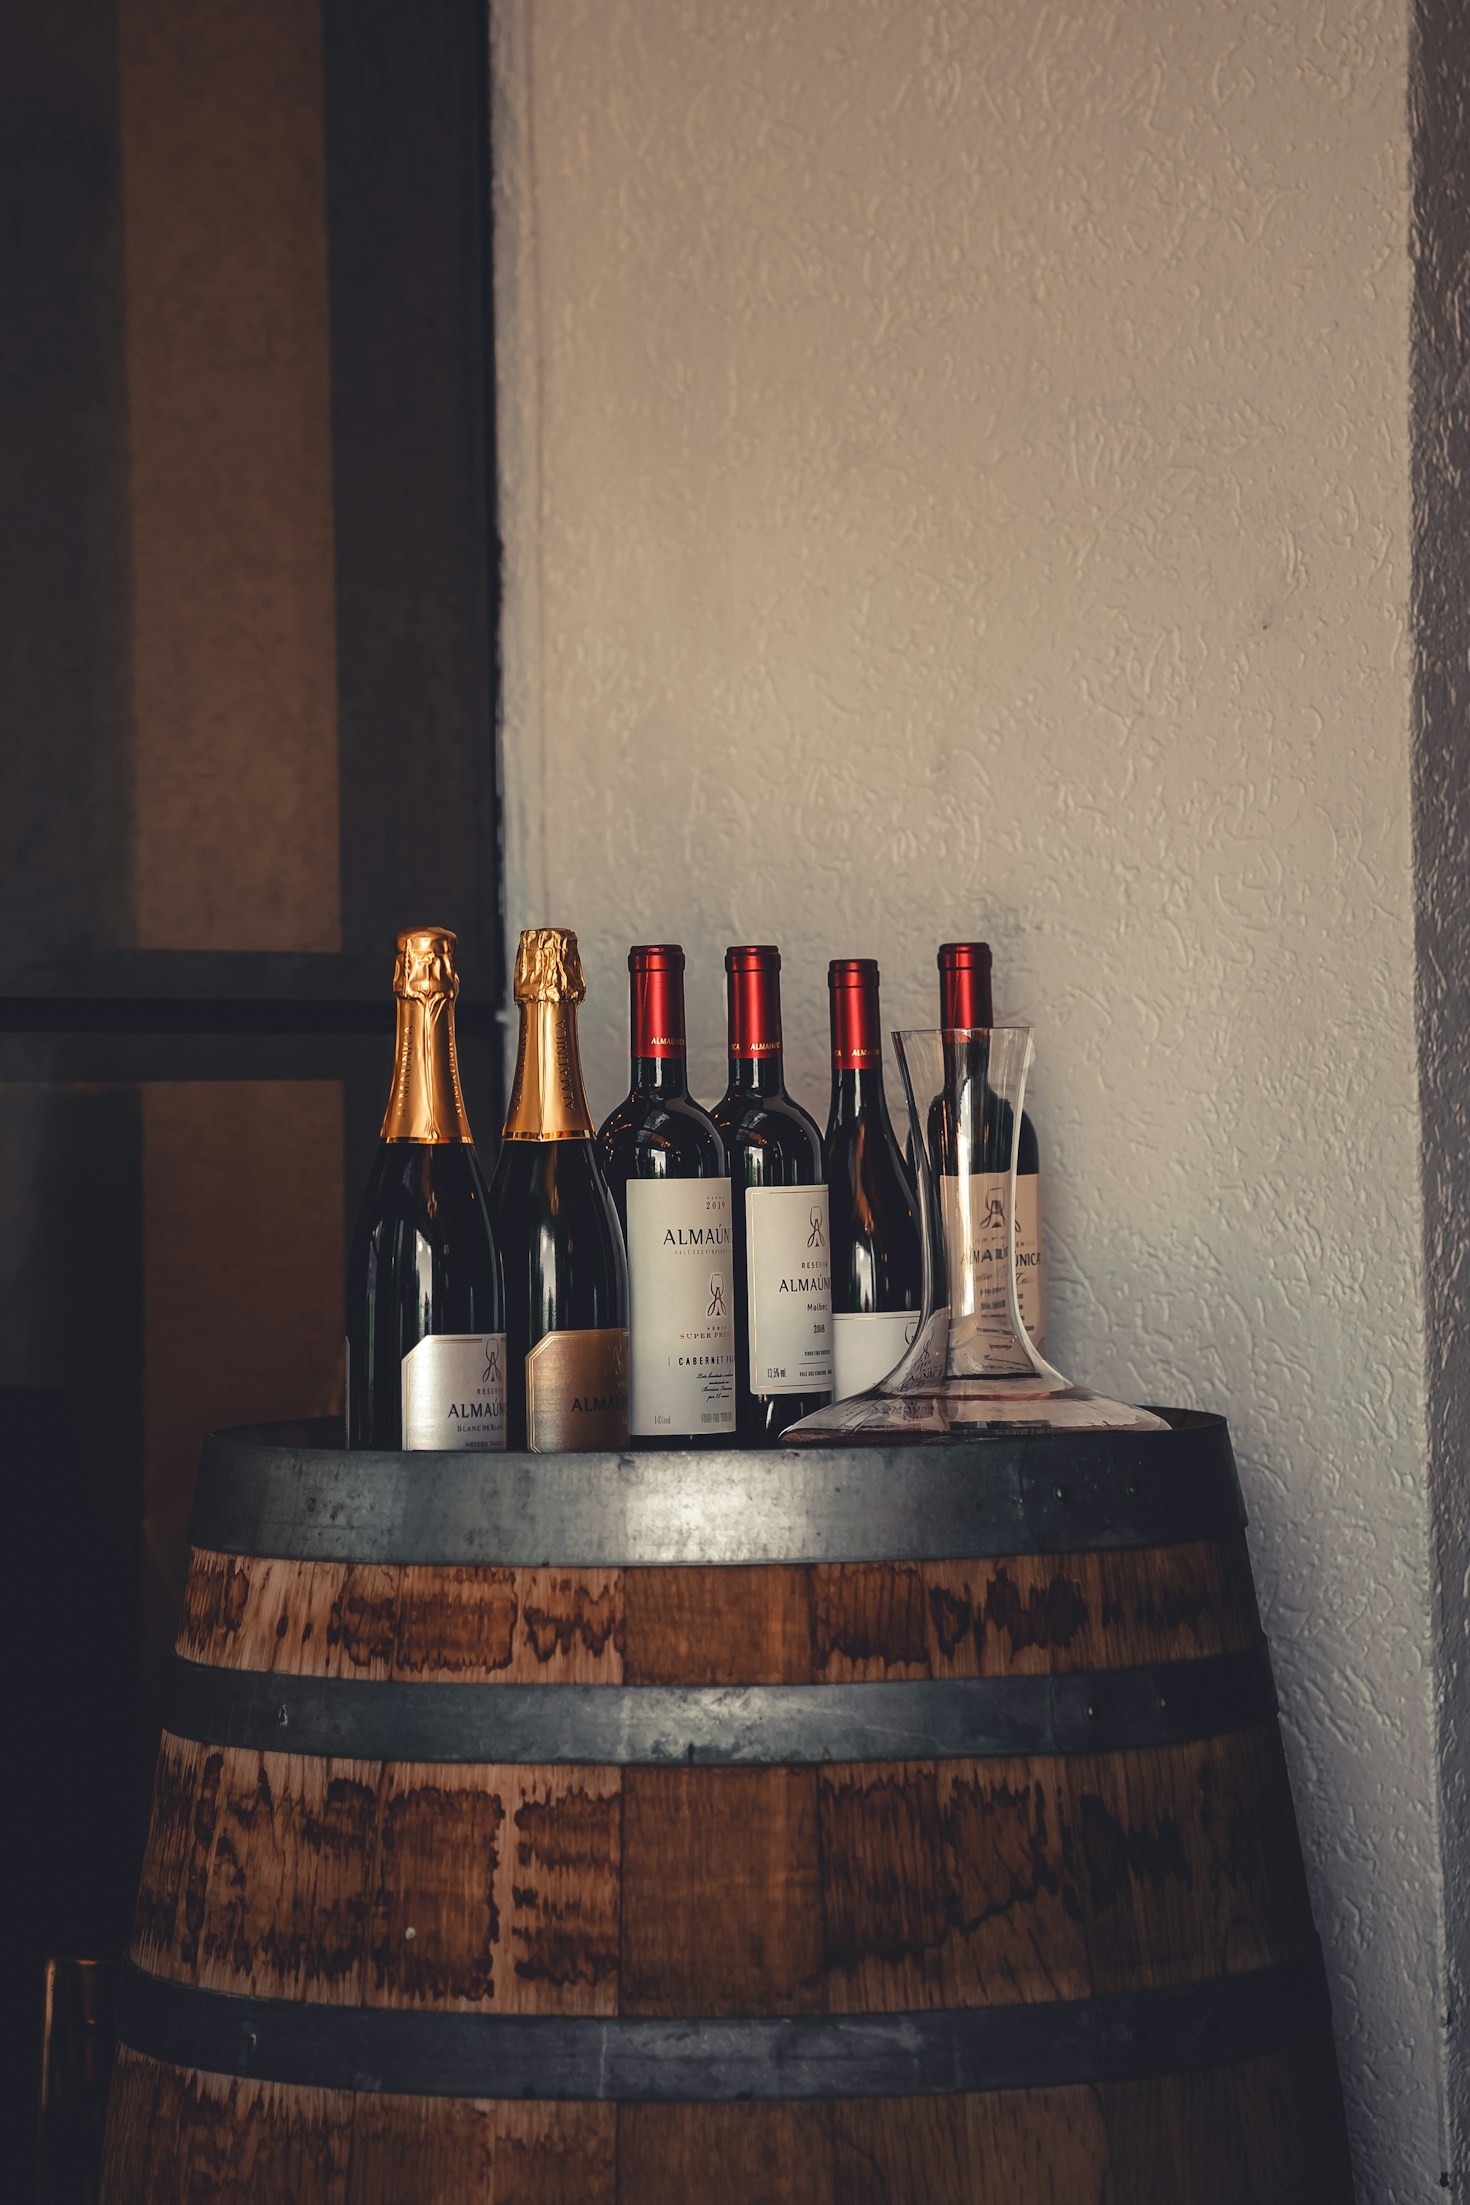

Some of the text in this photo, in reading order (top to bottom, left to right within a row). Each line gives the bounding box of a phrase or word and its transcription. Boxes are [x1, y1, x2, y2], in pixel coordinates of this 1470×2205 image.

[680, 1332, 712, 1340] SUPER
[678, 1355, 724, 1366] CABERNET
[570, 1392, 630, 1413] ALMAÚN
[457, 1424, 482, 1433] BLANC
